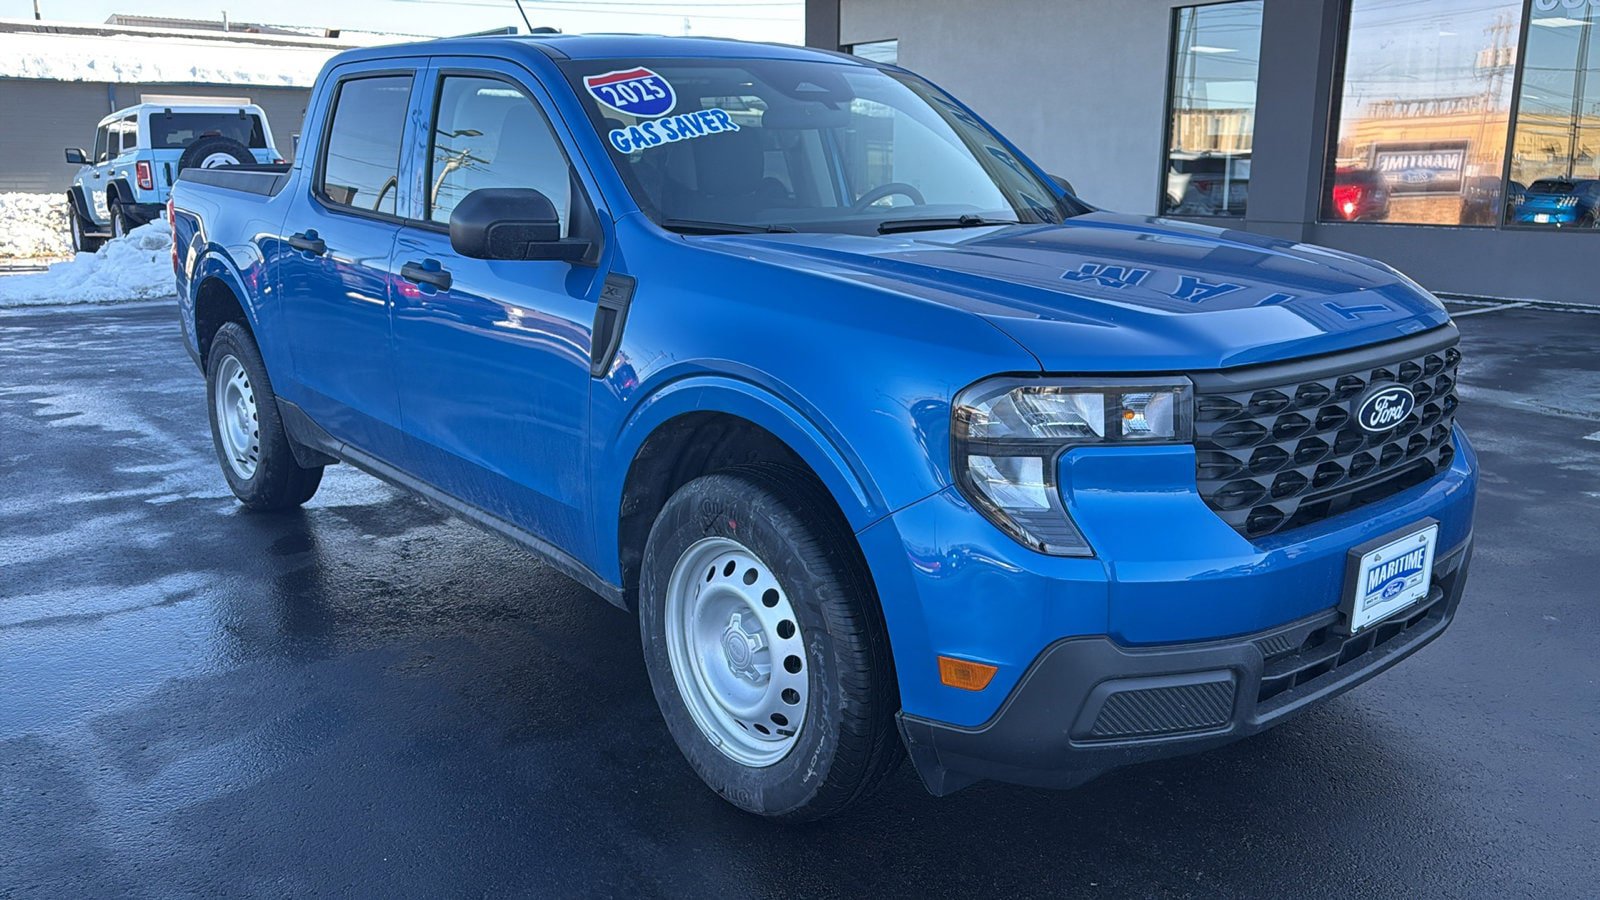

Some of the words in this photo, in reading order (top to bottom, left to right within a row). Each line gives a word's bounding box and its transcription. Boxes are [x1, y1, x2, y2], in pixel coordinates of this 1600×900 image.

[601, 78, 666, 107] 2025
[610, 122, 662, 153] GAS
[664, 109, 738, 142] SAVER
[1368, 392, 1406, 428] Ford
[1367, 547, 1425, 594] MARITIME
[1384, 580, 1404, 598] Ford
